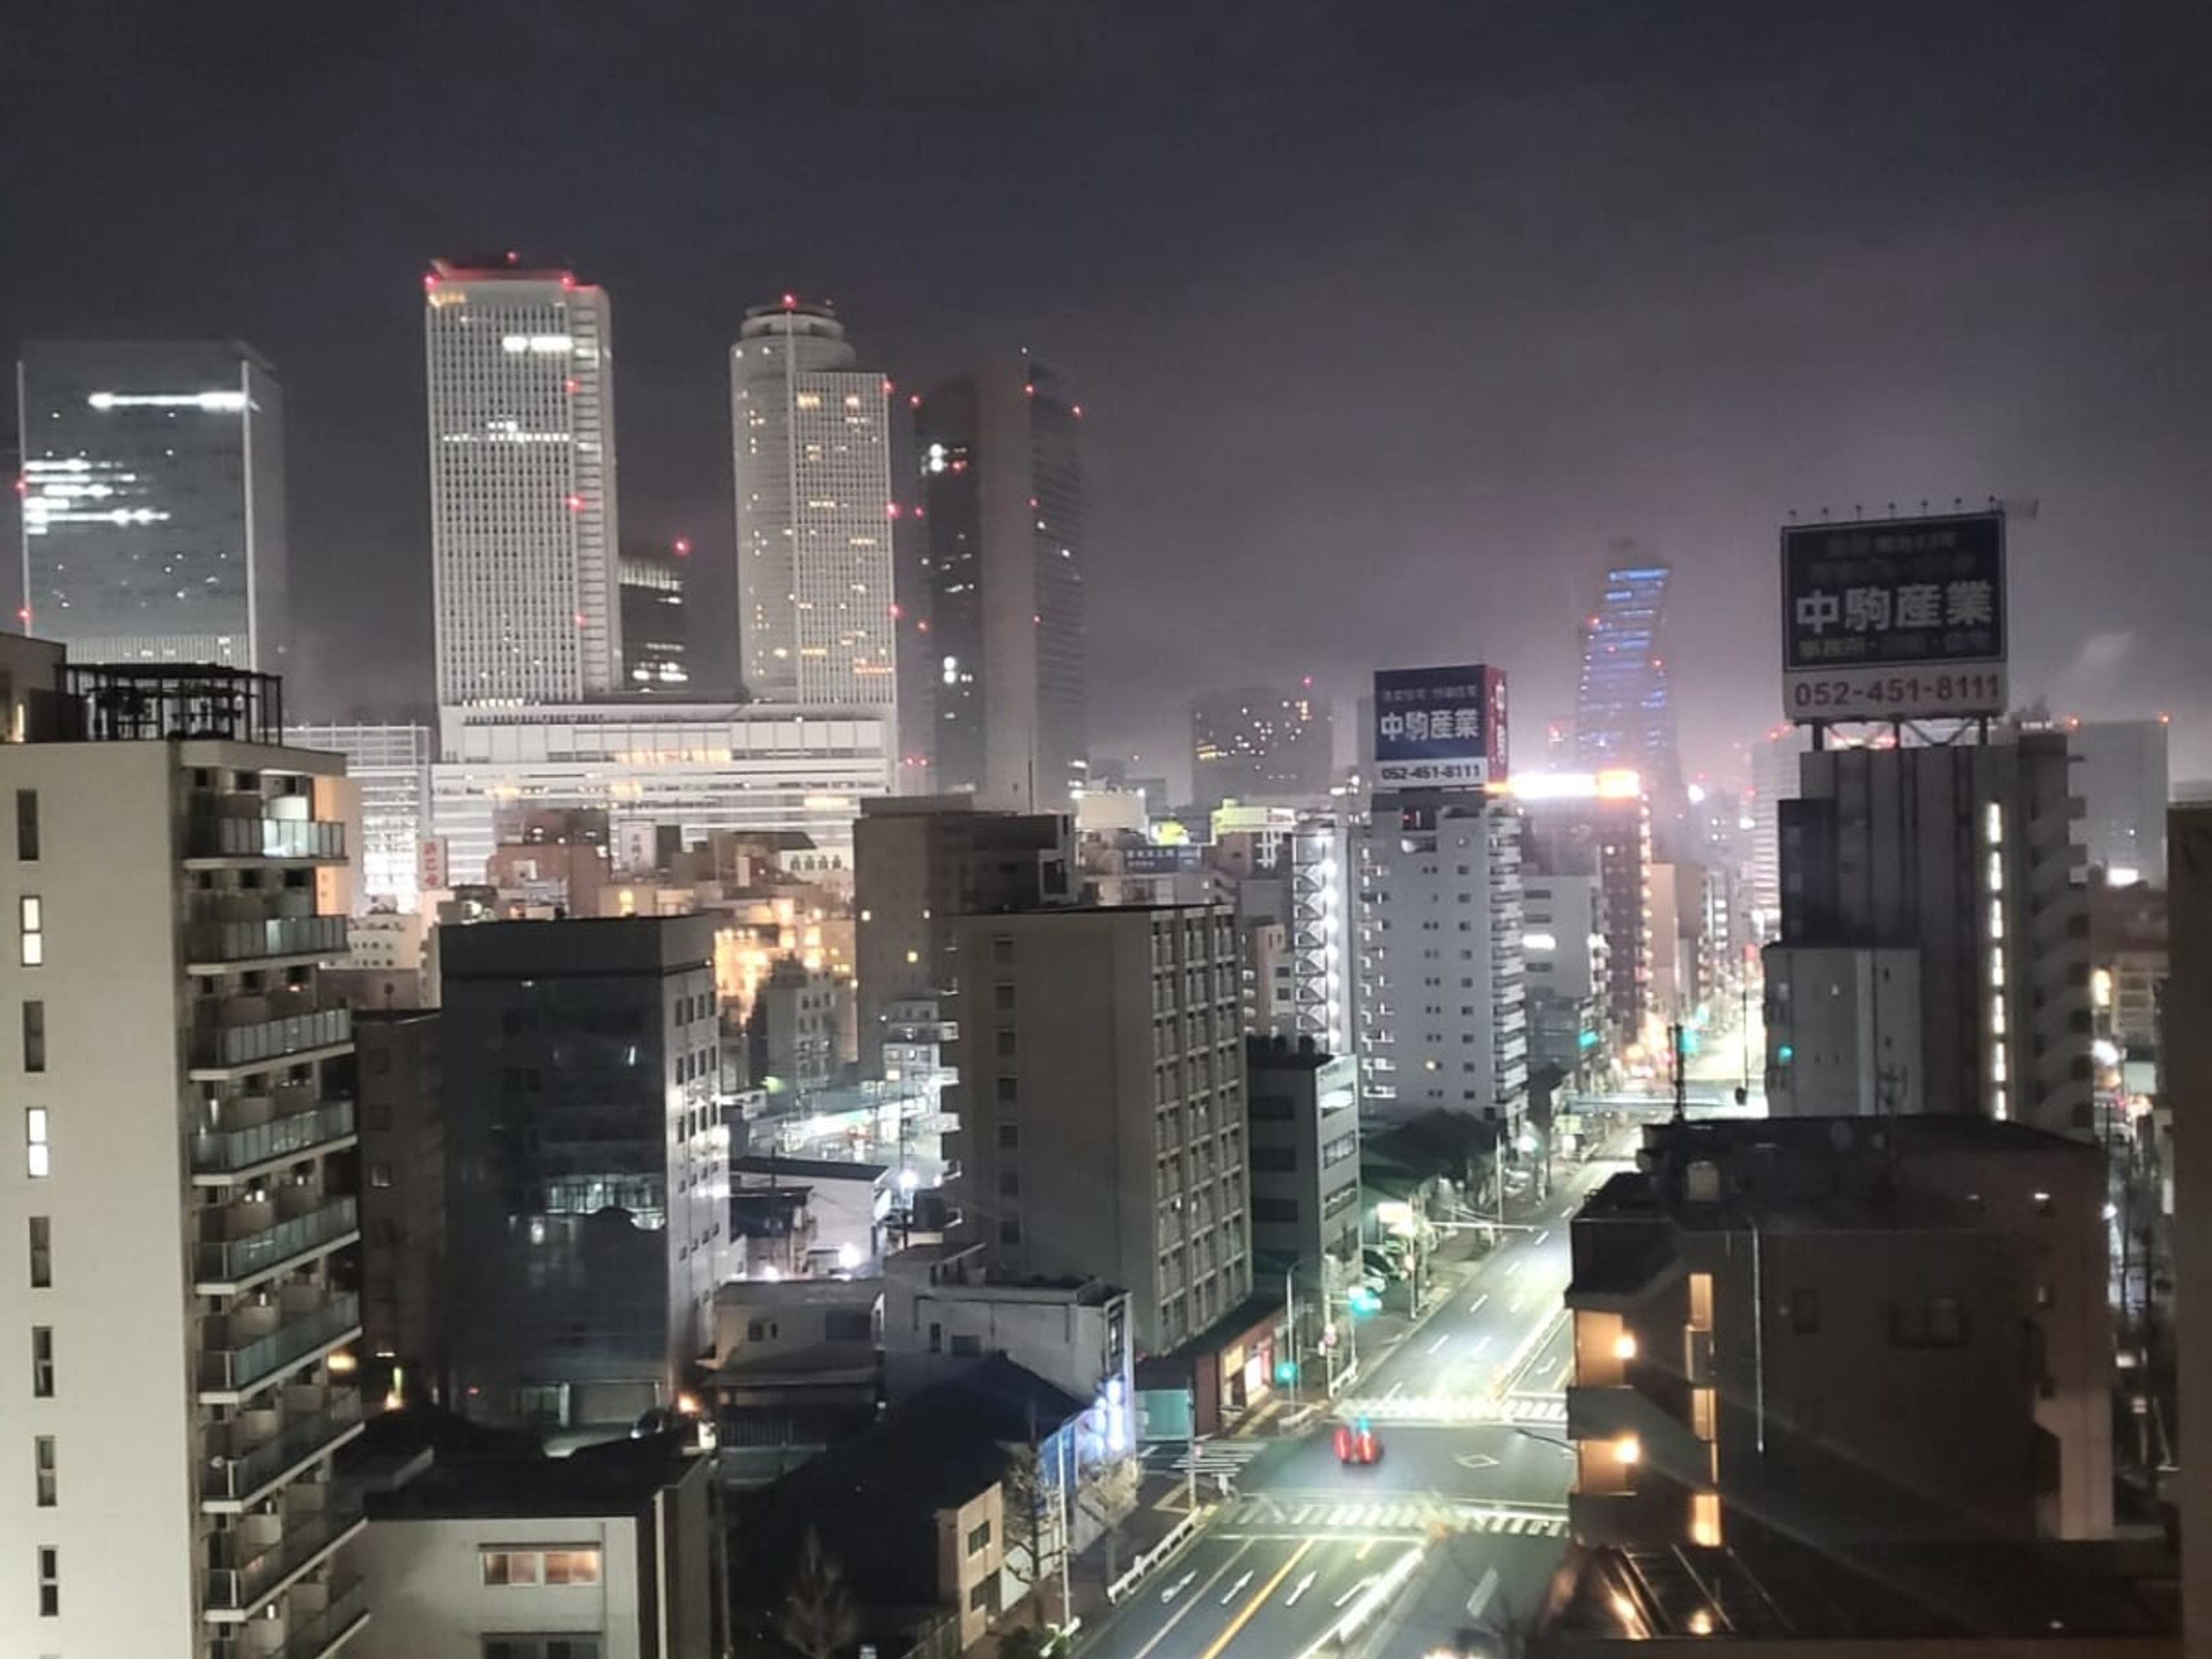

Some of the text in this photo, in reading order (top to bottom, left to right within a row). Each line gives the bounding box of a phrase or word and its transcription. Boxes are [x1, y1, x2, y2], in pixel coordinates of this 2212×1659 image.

[1796, 579, 1993, 634] 中駒産業
[1794, 673, 1999, 707] 052-451-8111
[1381, 708, 1479, 742] 中駒産業
[1382, 764, 1480, 781] 052-451-8111
